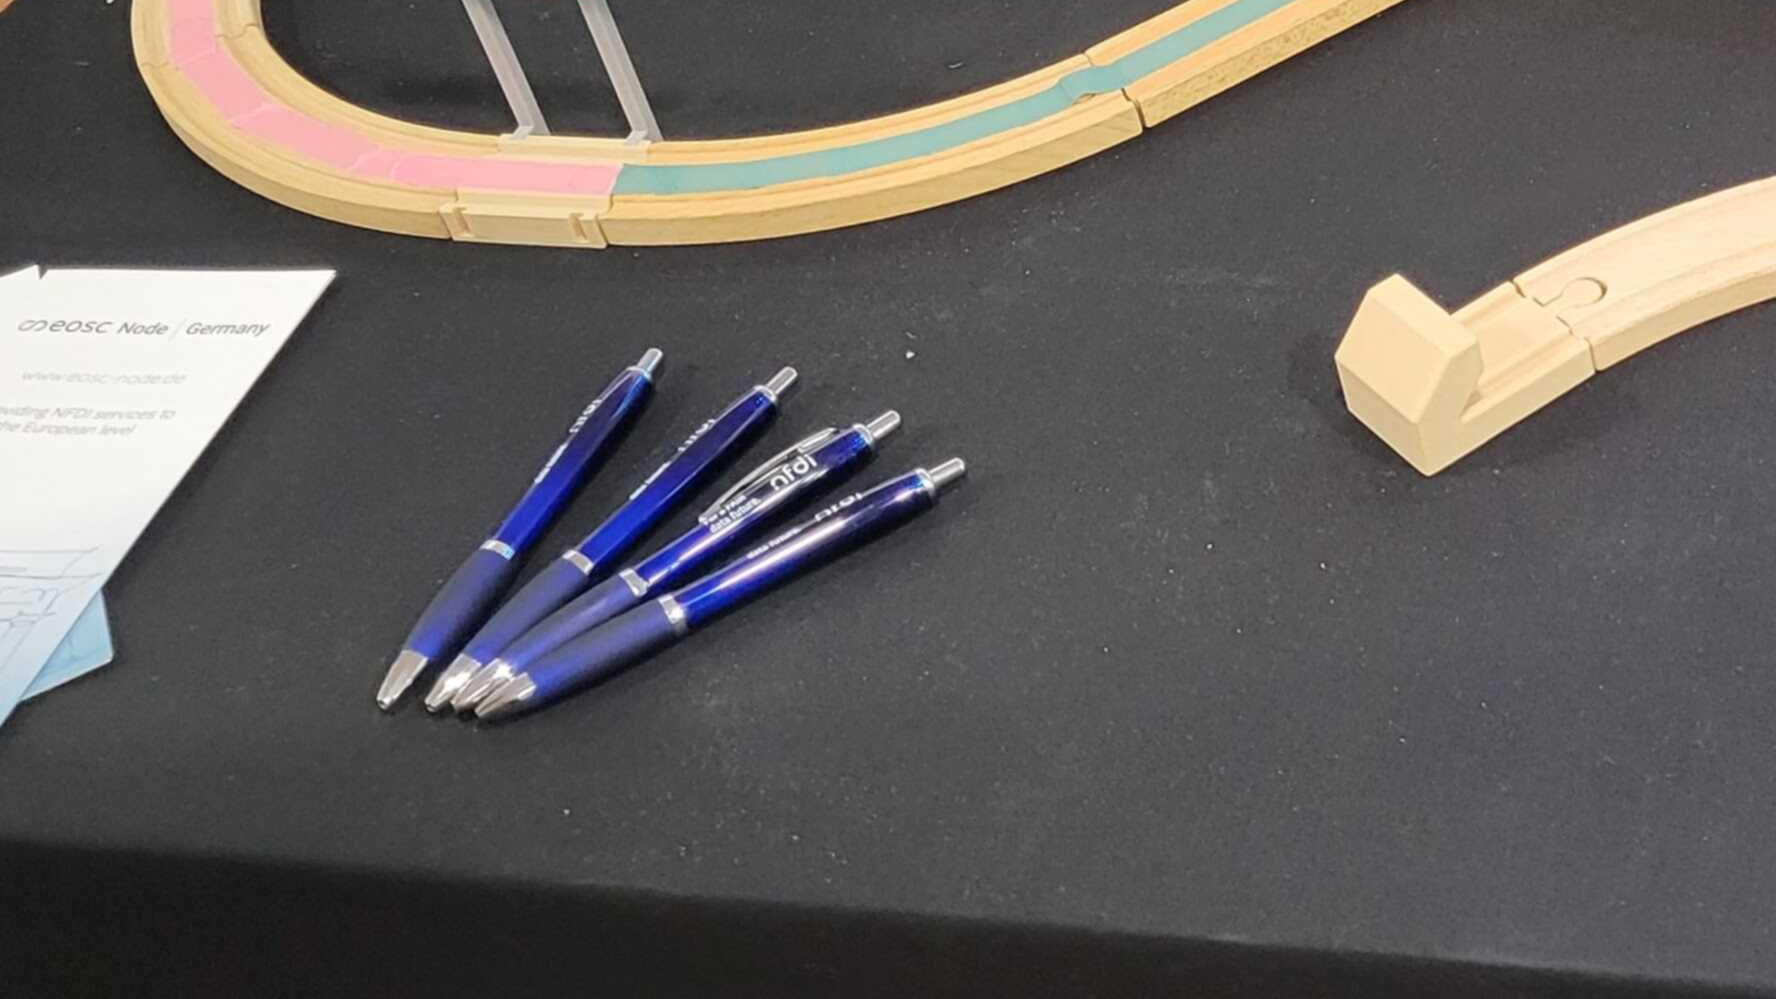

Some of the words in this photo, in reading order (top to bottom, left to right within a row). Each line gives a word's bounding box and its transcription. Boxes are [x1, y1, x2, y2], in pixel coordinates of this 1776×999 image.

[49, 320, 113, 334] eosc
[117, 321, 169, 336] Node
[186, 321, 271, 337] Germany
[770, 454, 818, 490] nfdi
[709, 517, 731, 534] data
